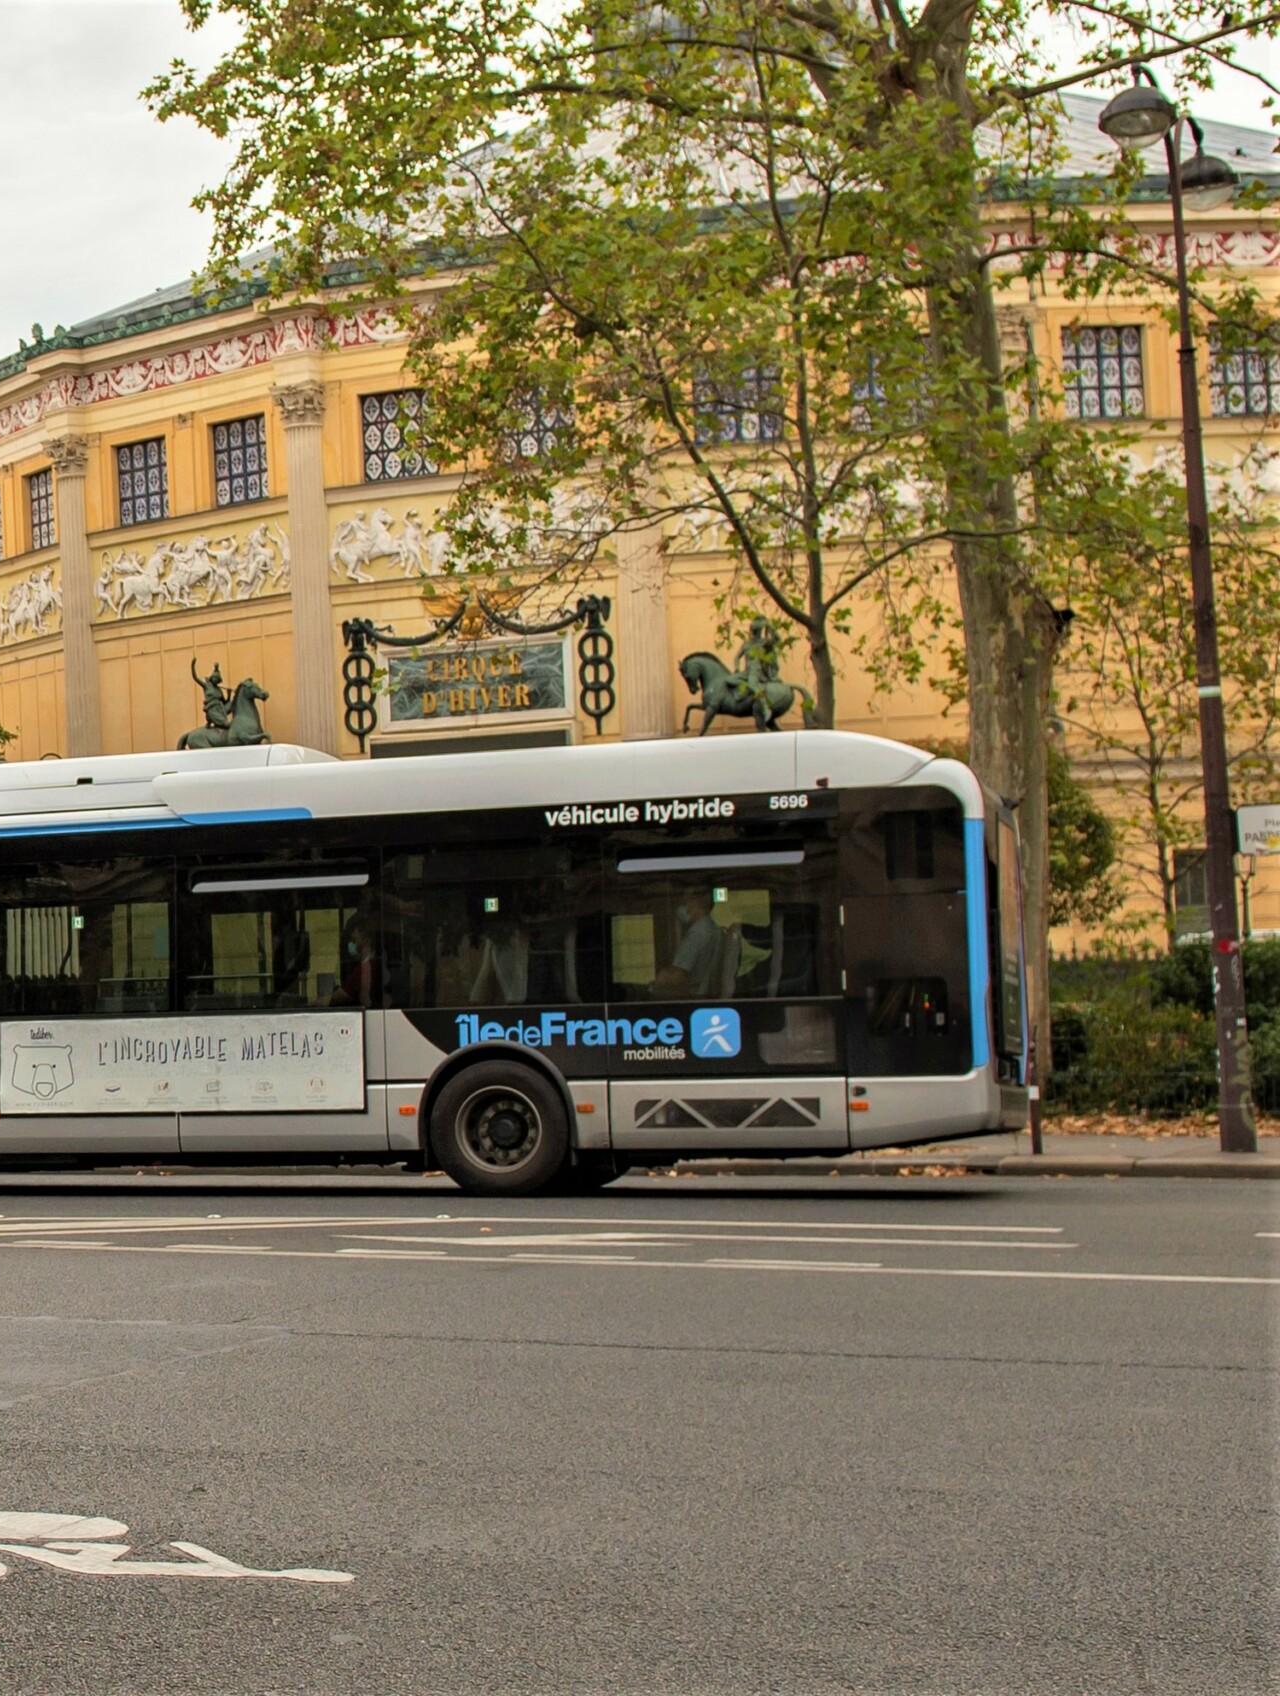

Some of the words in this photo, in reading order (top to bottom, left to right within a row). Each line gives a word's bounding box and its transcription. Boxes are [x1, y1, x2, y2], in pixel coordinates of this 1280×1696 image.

[426, 651, 524, 682] CIRQUE
[421, 684, 531, 715] D'HIVER
[545, 803, 639, 826] véhicule
[644, 797, 736, 824] hybride
[769, 794, 809, 810] 5696
[98, 1035, 228, 1066] L'INCROYABLE
[240, 1031, 324, 1061] MATELAS
[623, 1044, 686, 1062] mobilités
